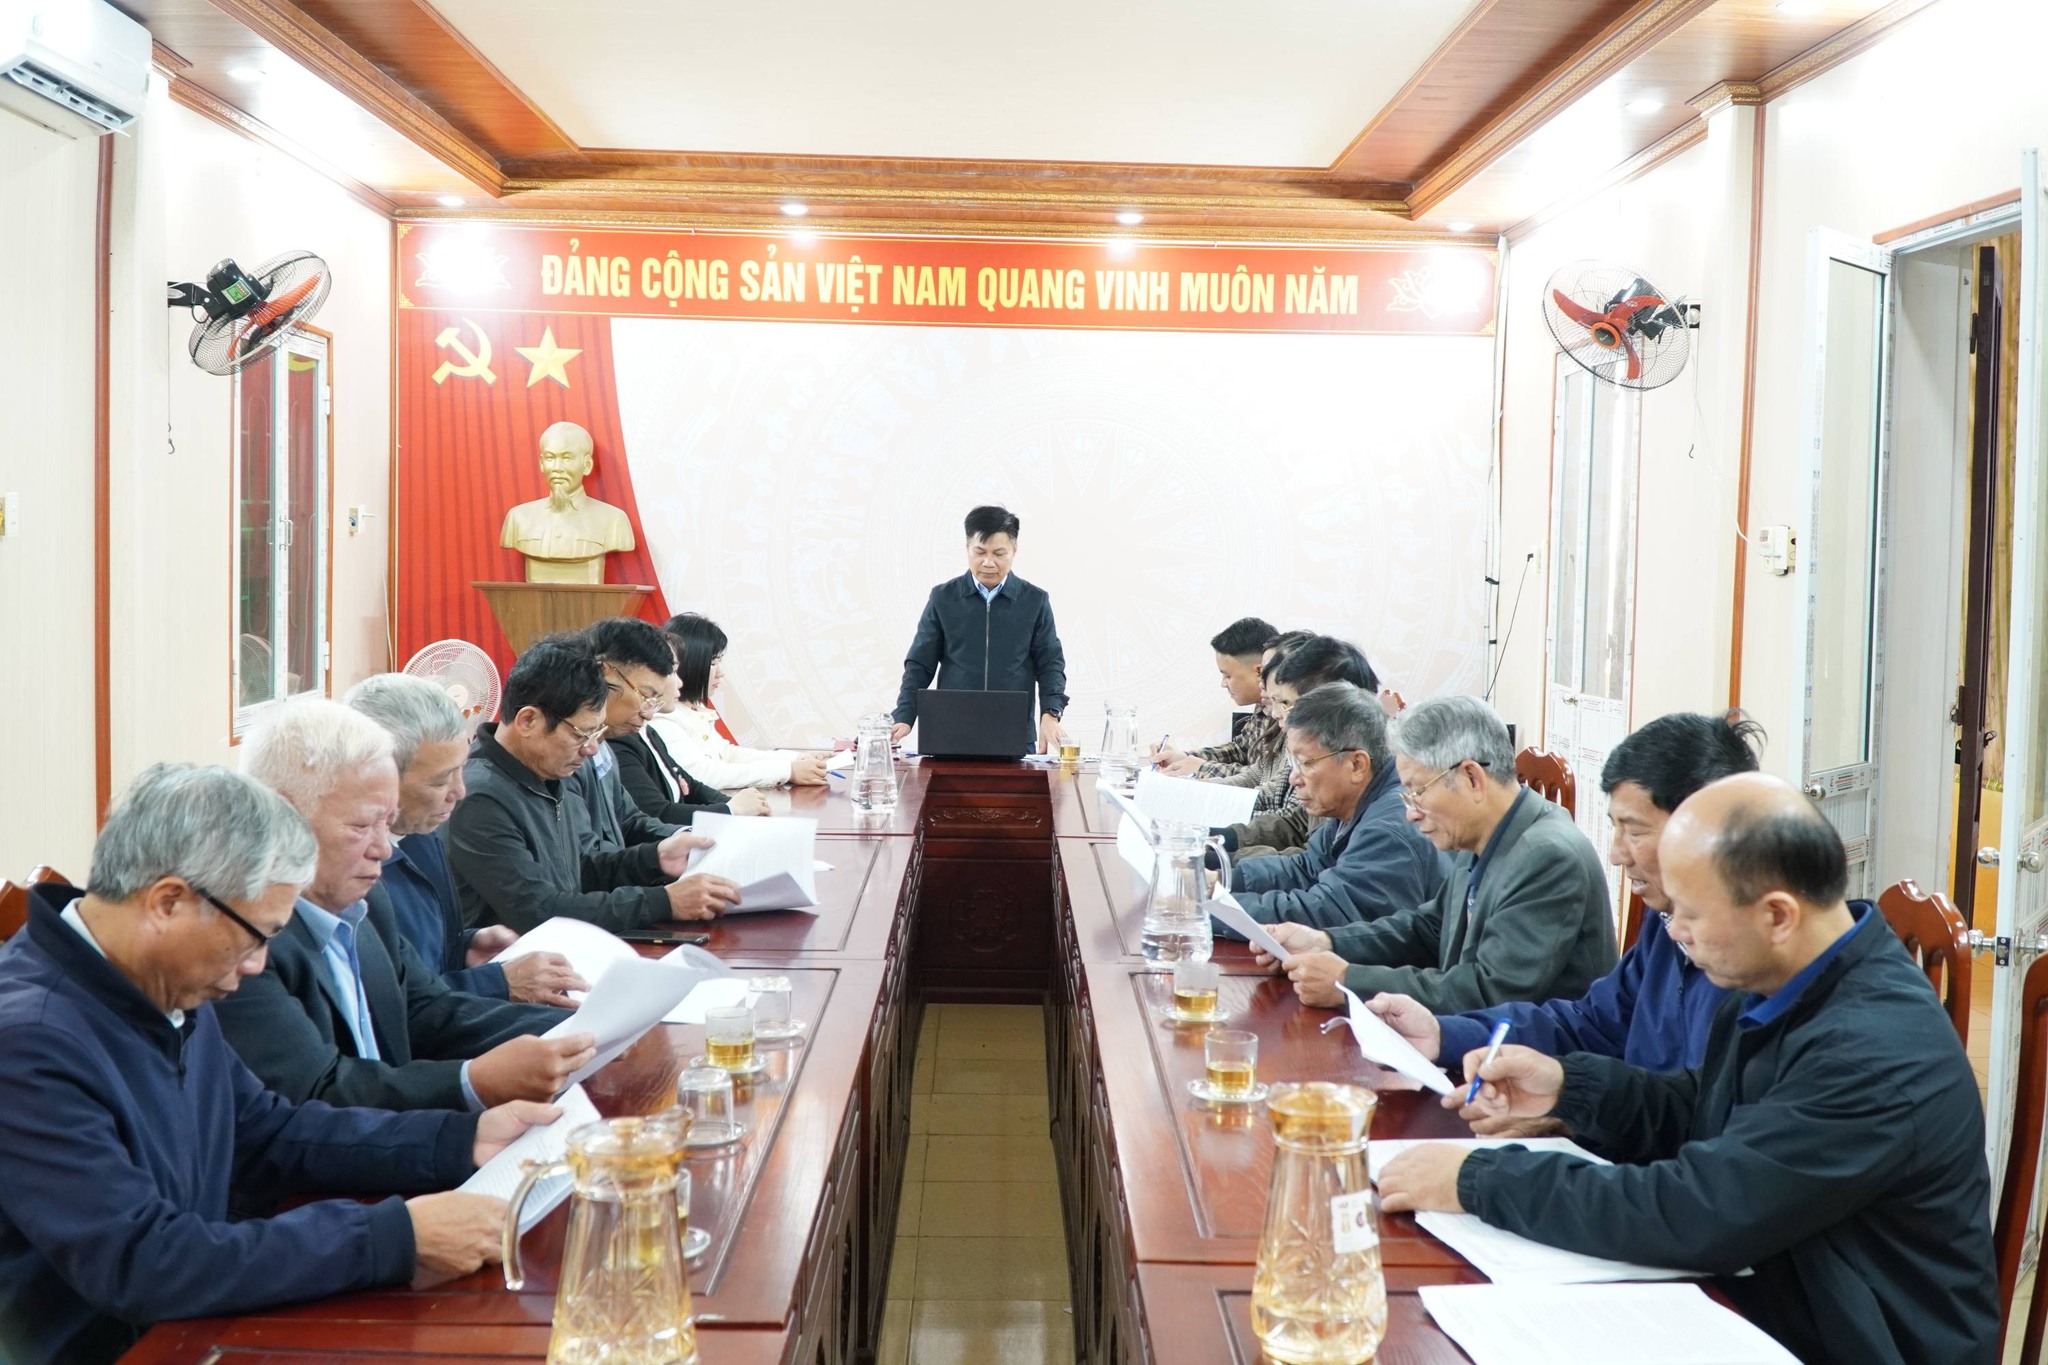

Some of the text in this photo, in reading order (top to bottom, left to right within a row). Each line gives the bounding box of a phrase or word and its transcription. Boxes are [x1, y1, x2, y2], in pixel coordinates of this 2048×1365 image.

[541, 238, 1359, 315] ĐẢNG CỘNG SẢN VIỆT NAM QUANG VINH MUÔN NĂM
